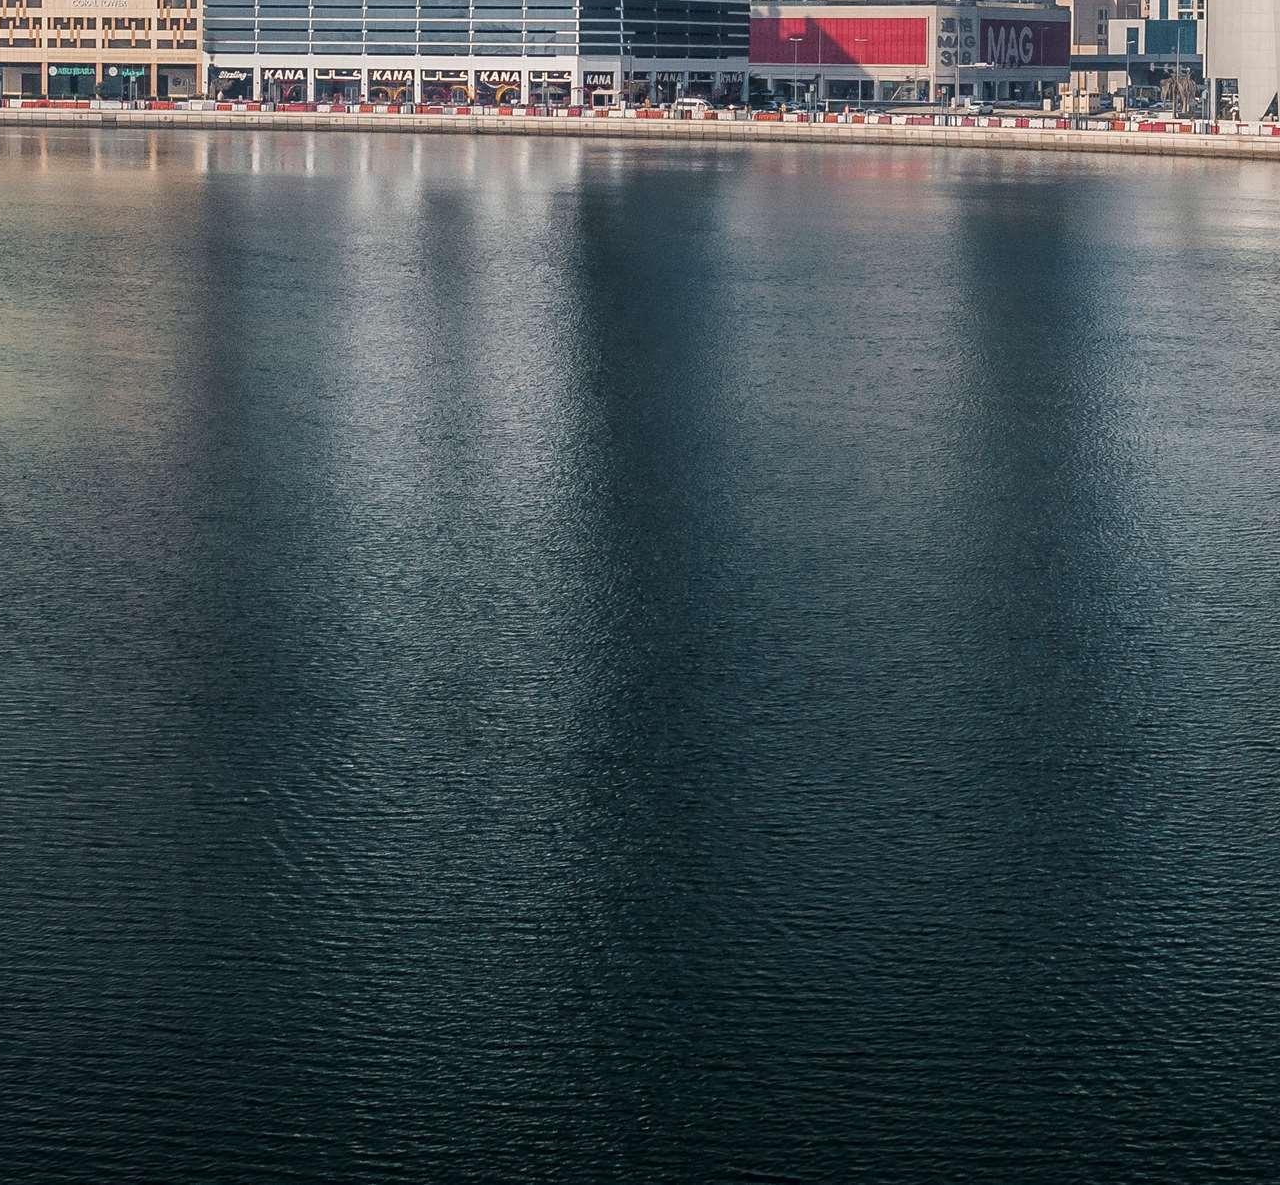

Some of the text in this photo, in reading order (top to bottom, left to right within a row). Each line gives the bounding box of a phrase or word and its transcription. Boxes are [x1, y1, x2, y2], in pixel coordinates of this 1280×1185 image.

[71, 0, 128, 7] CORAL TOWER
[938, 35, 976, 49] MAG
[987, 26, 1034, 64] MAG
[264, 69, 305, 80] KANA
[372, 70, 413, 81] KANA
[479, 71, 520, 82] KANA
[586, 74, 611, 85] KANA
[720, 72, 743, 84] KANA
